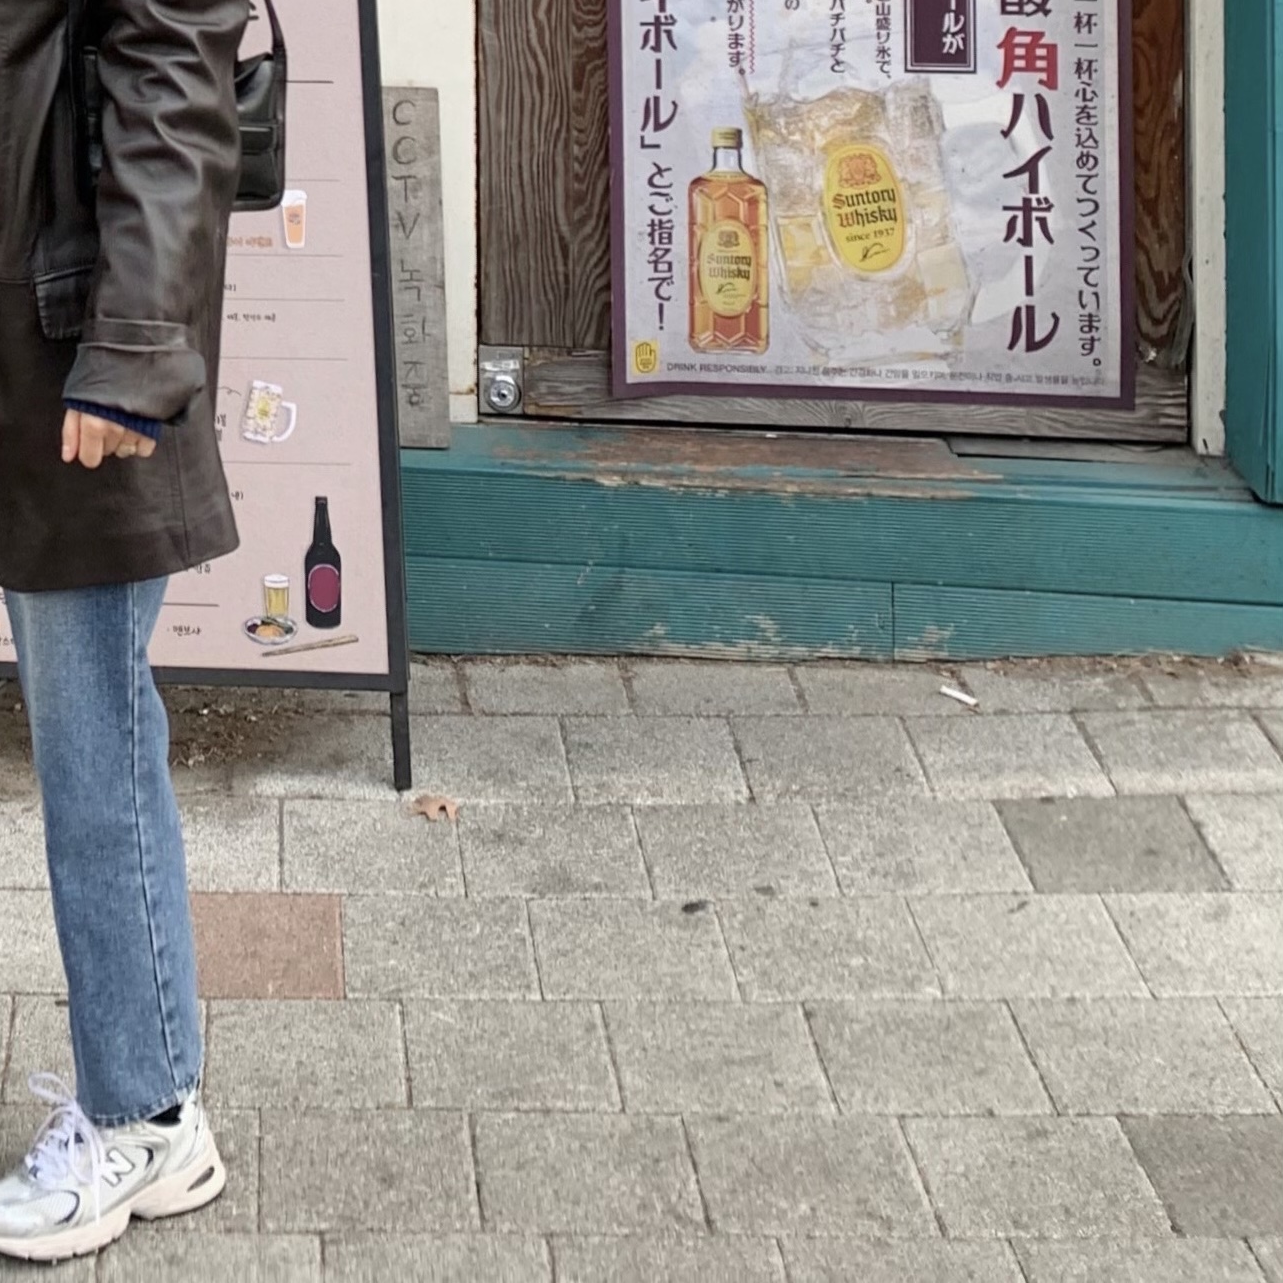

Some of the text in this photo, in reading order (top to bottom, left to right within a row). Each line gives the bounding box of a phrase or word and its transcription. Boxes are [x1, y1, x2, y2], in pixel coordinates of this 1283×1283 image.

[832, 187, 896, 211] Suntory
[837, 205, 898, 228] Whisky
[845, 227, 896, 243] since 1937
[391, 99, 432, 408] CCTV 녹화중
[707, 253, 752, 267] Suntory
[709, 267, 750, 281] Whisky
[98, 1148, 136, 1187] N
